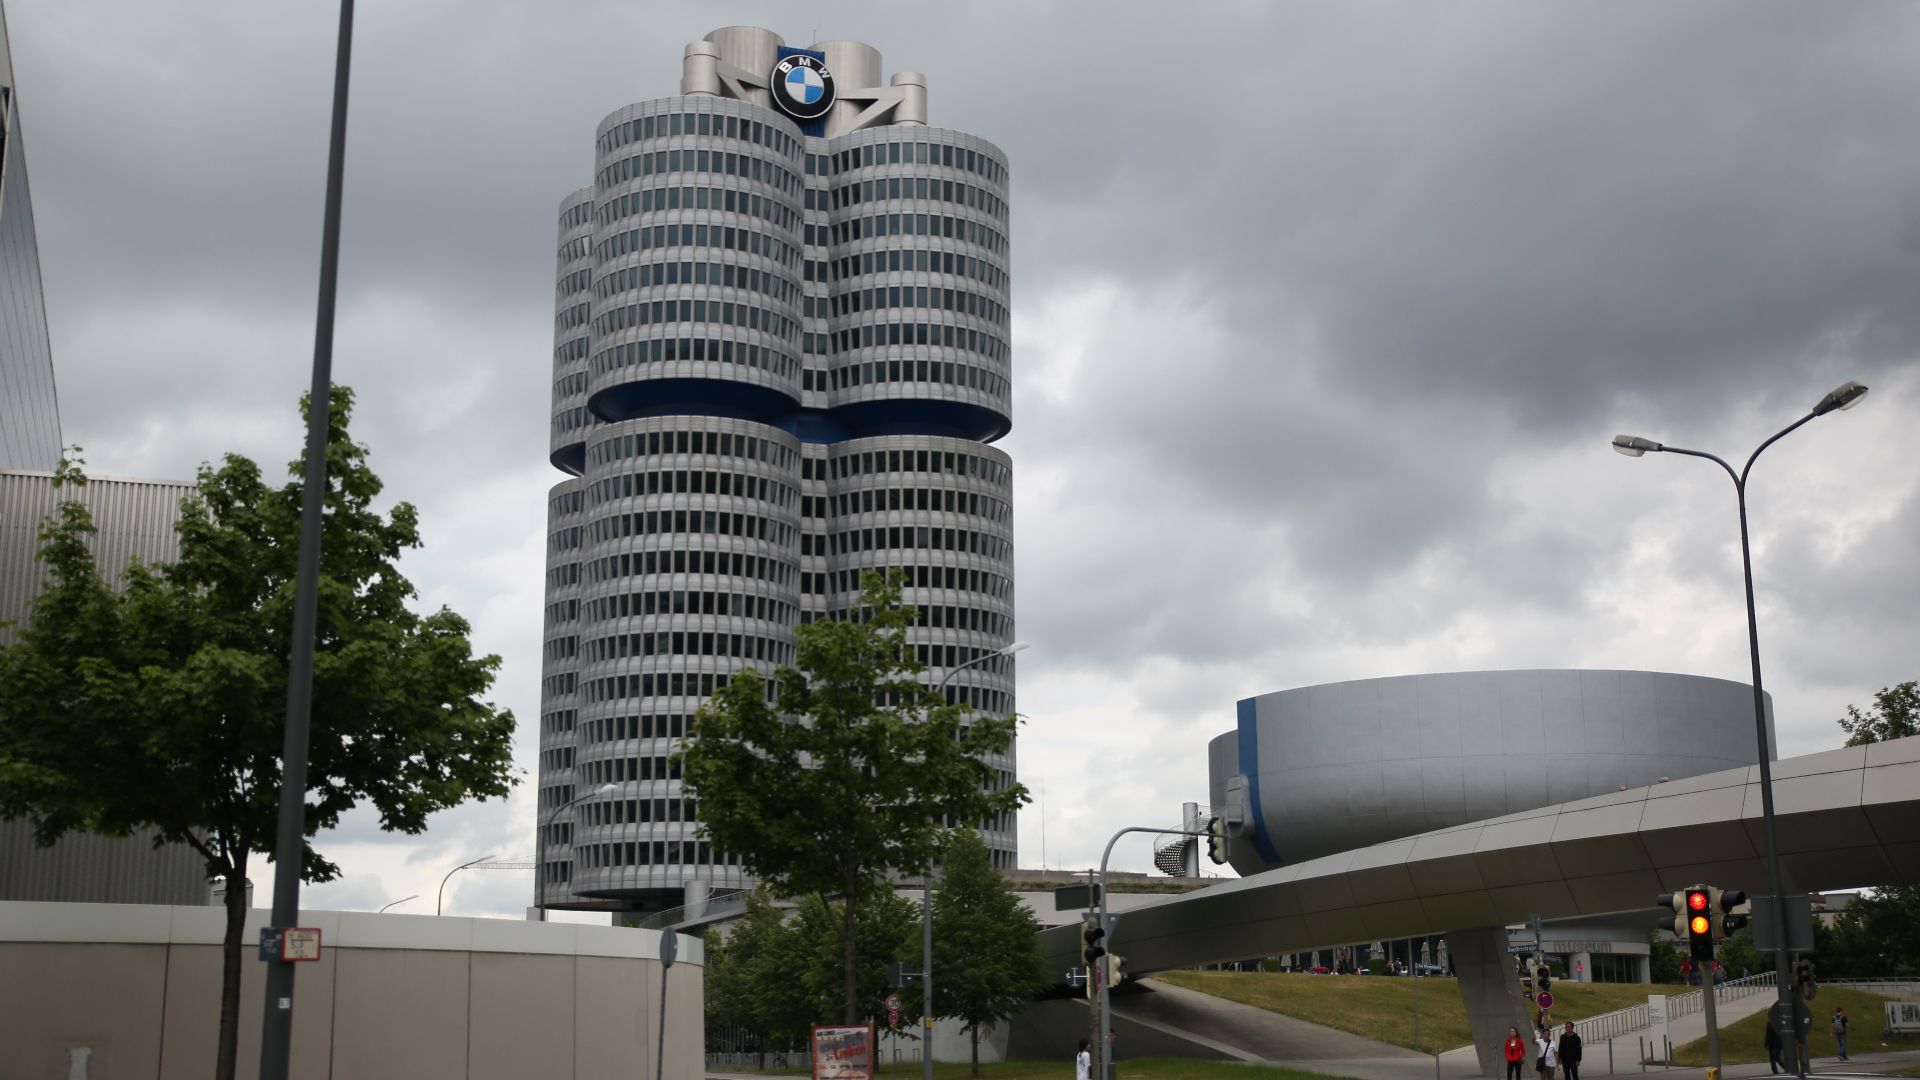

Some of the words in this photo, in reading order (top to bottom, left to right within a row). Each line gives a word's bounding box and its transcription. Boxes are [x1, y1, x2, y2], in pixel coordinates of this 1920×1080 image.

[779, 56, 831, 79] BMW
[1553, 941, 1612, 953] museum
[889, 999, 900, 1007] 30
